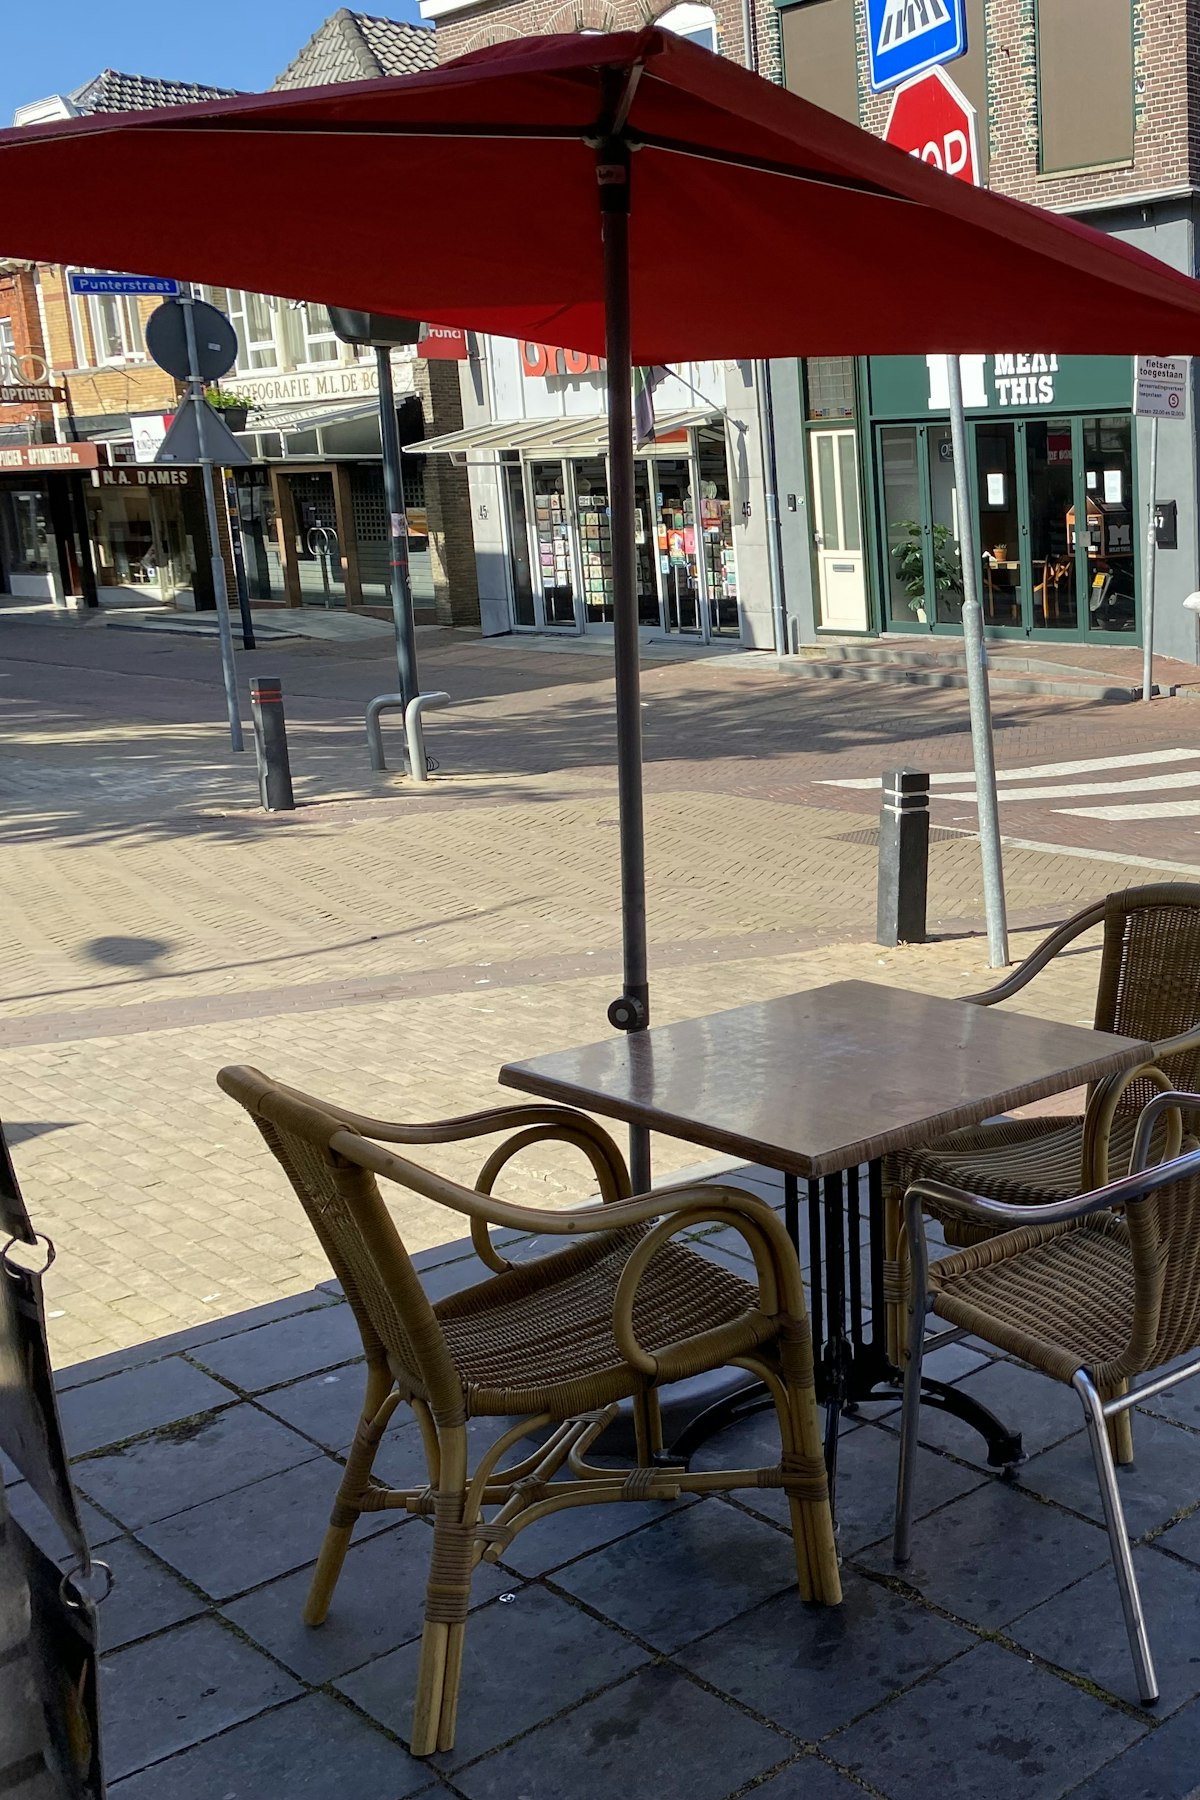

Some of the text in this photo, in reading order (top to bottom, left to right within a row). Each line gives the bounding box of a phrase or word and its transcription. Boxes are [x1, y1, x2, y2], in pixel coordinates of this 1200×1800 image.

[909, 129, 967, 175] OP
[79, 279, 171, 291] Punterstraat
[994, 353, 1059, 376] MEAT
[1146, 359, 1176, 370] fietsers
[1140, 368, 1183, 379] toegestaan
[237, 369, 397, 401] FOTOGRAFIE M.L. DE BOR
[995, 375, 1054, 406] THIS
[1, 387, 54, 401] OPTICIEN
[103, 470, 189, 485] N.A. DAMES
[478, 504, 489, 519] 45
